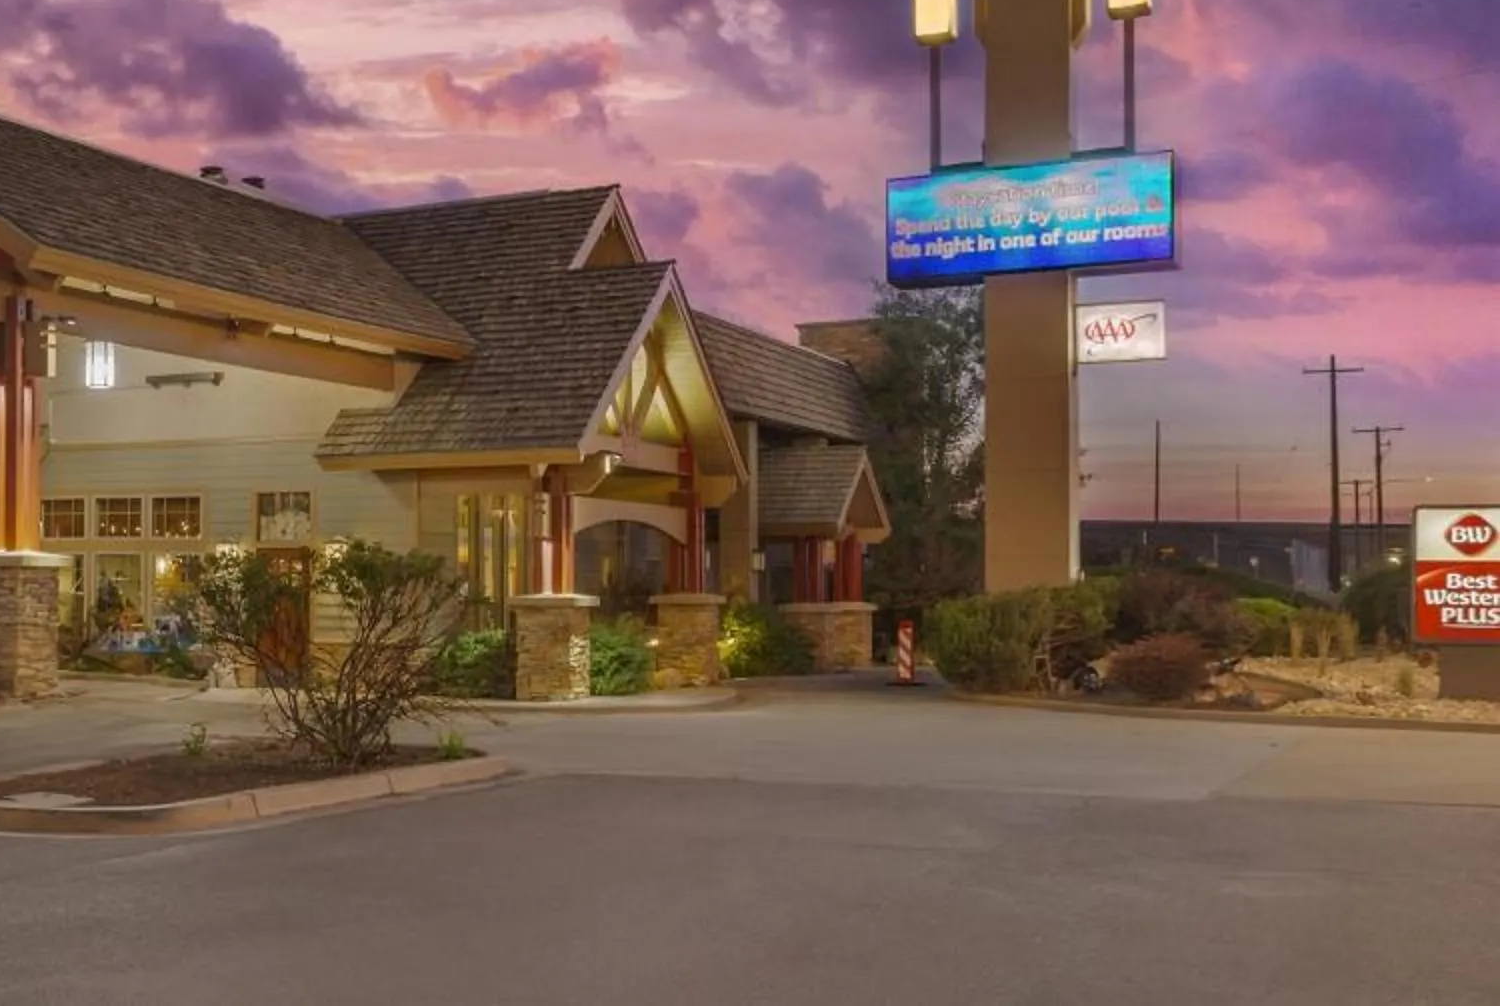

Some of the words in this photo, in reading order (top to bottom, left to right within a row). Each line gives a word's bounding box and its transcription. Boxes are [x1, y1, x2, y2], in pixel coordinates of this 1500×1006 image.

[991, 205, 1023, 229] day
[1029, 207, 1051, 226] by
[925, 237, 975, 259] night
[978, 235, 996, 252] in
[1000, 230, 1036, 249] one
[1040, 227, 1062, 246] of
[1066, 228, 1099, 244] our
[1088, 317, 1134, 343] AAA
[1452, 526, 1492, 543] BW
[1446, 573, 1498, 589] Best
[1423, 589, 1500, 606] Wester
